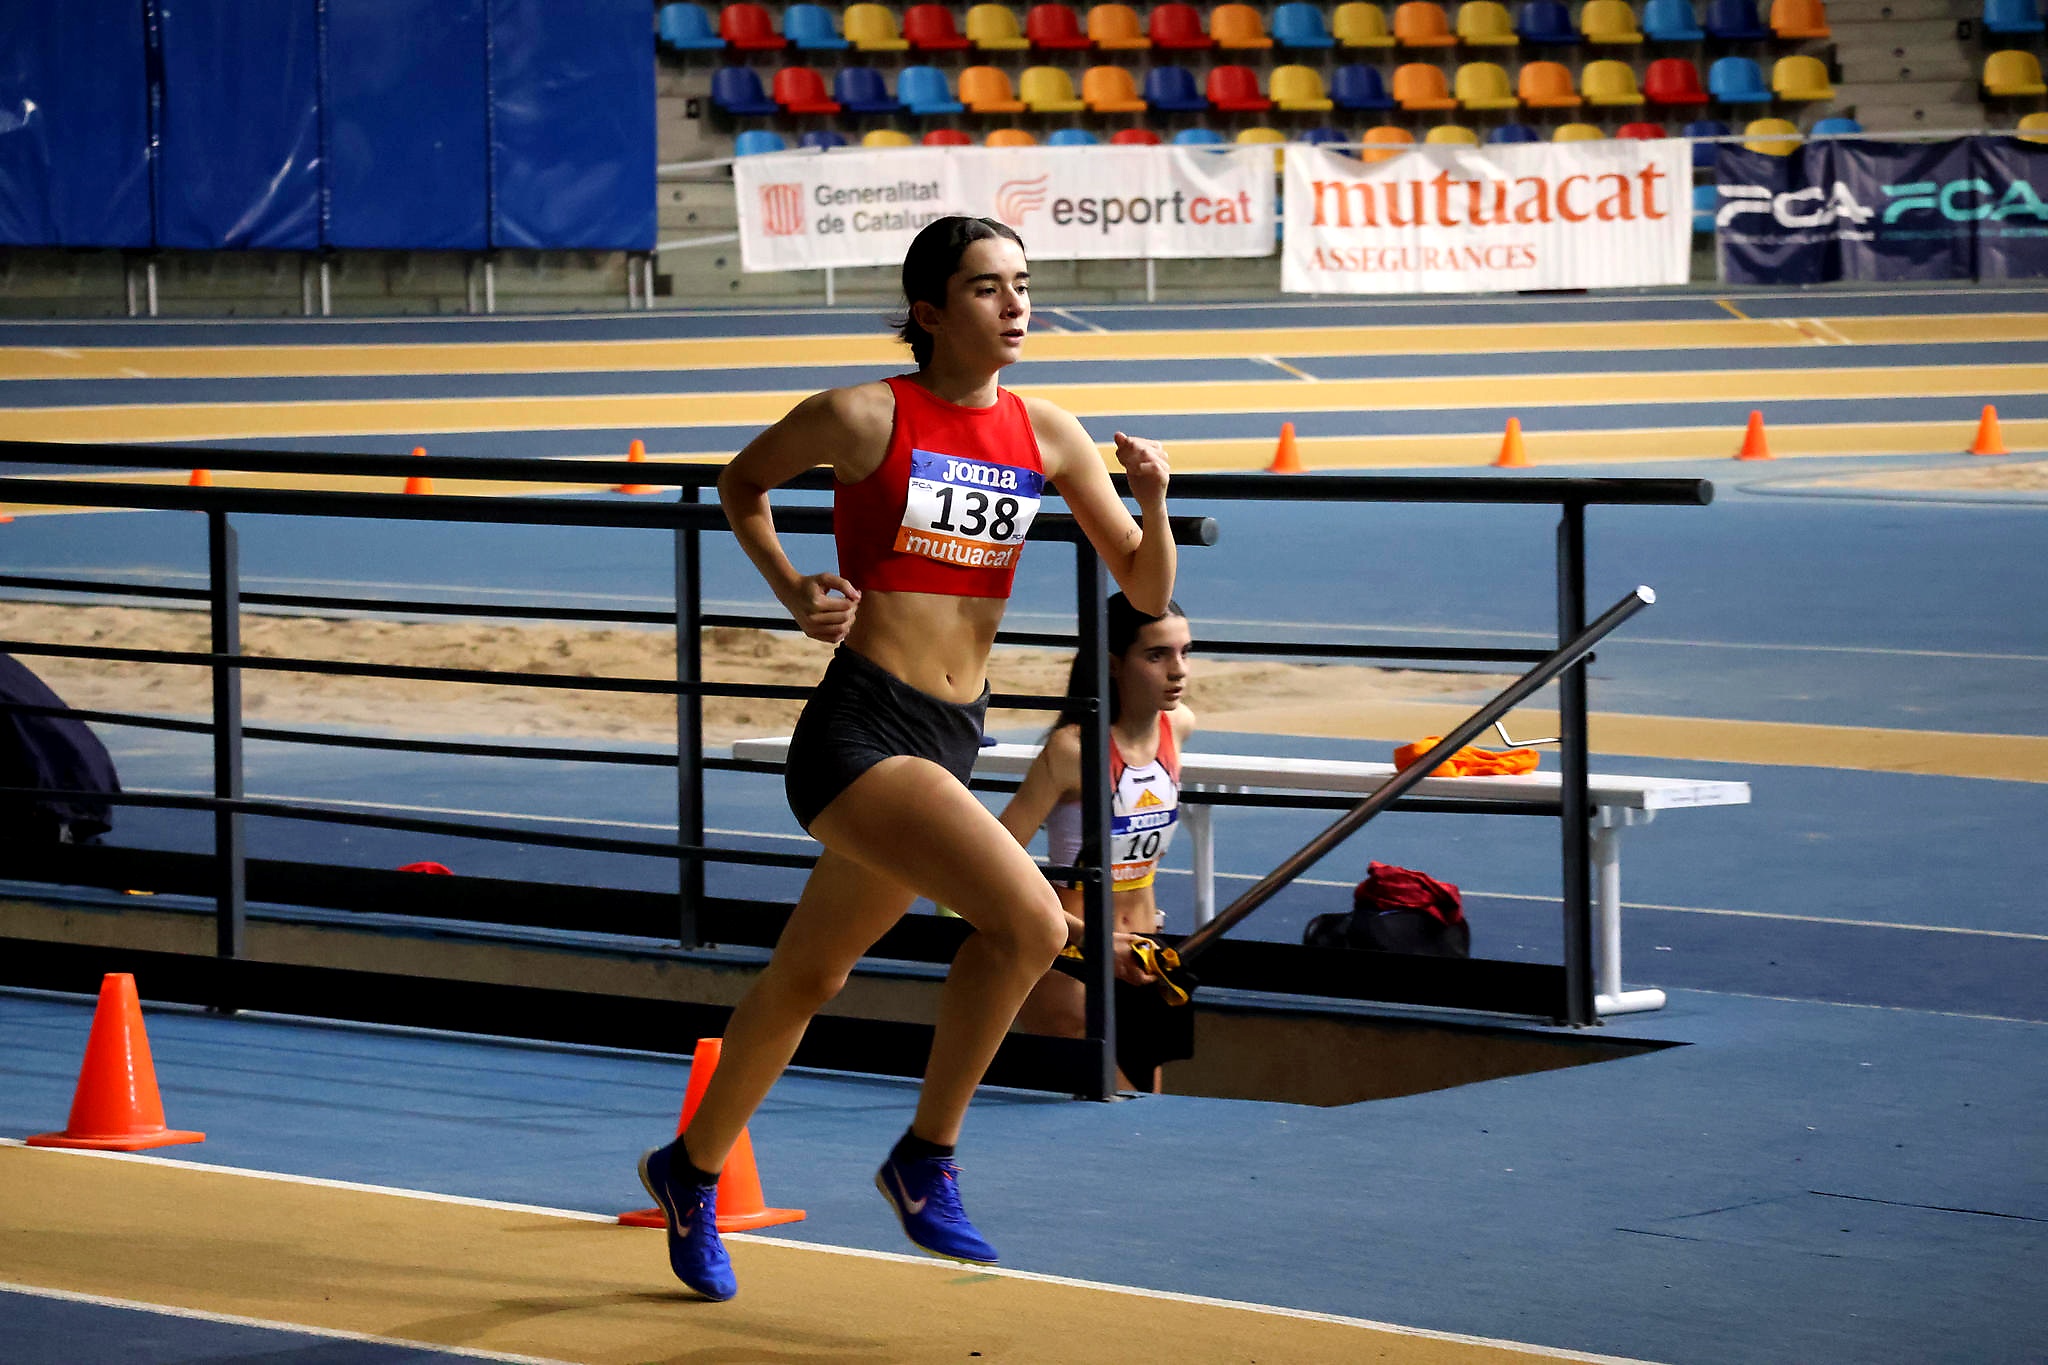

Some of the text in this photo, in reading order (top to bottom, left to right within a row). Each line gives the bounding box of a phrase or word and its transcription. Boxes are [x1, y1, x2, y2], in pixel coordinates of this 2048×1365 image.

[814, 180, 940, 206] Generalitat
[1052, 189, 1252, 236] esportcat
[1310, 161, 1669, 228] mutuacat
[1715, 180, 1875, 227] FCA
[1880, 178, 2048, 224] FCA
[816, 212, 845, 234] de
[1308, 243, 1537, 273] ASSEGURANCES
[930, 486, 1019, 541] 138
[905, 534, 1014, 567] mutuacat
[1122, 830, 1161, 861] 10
